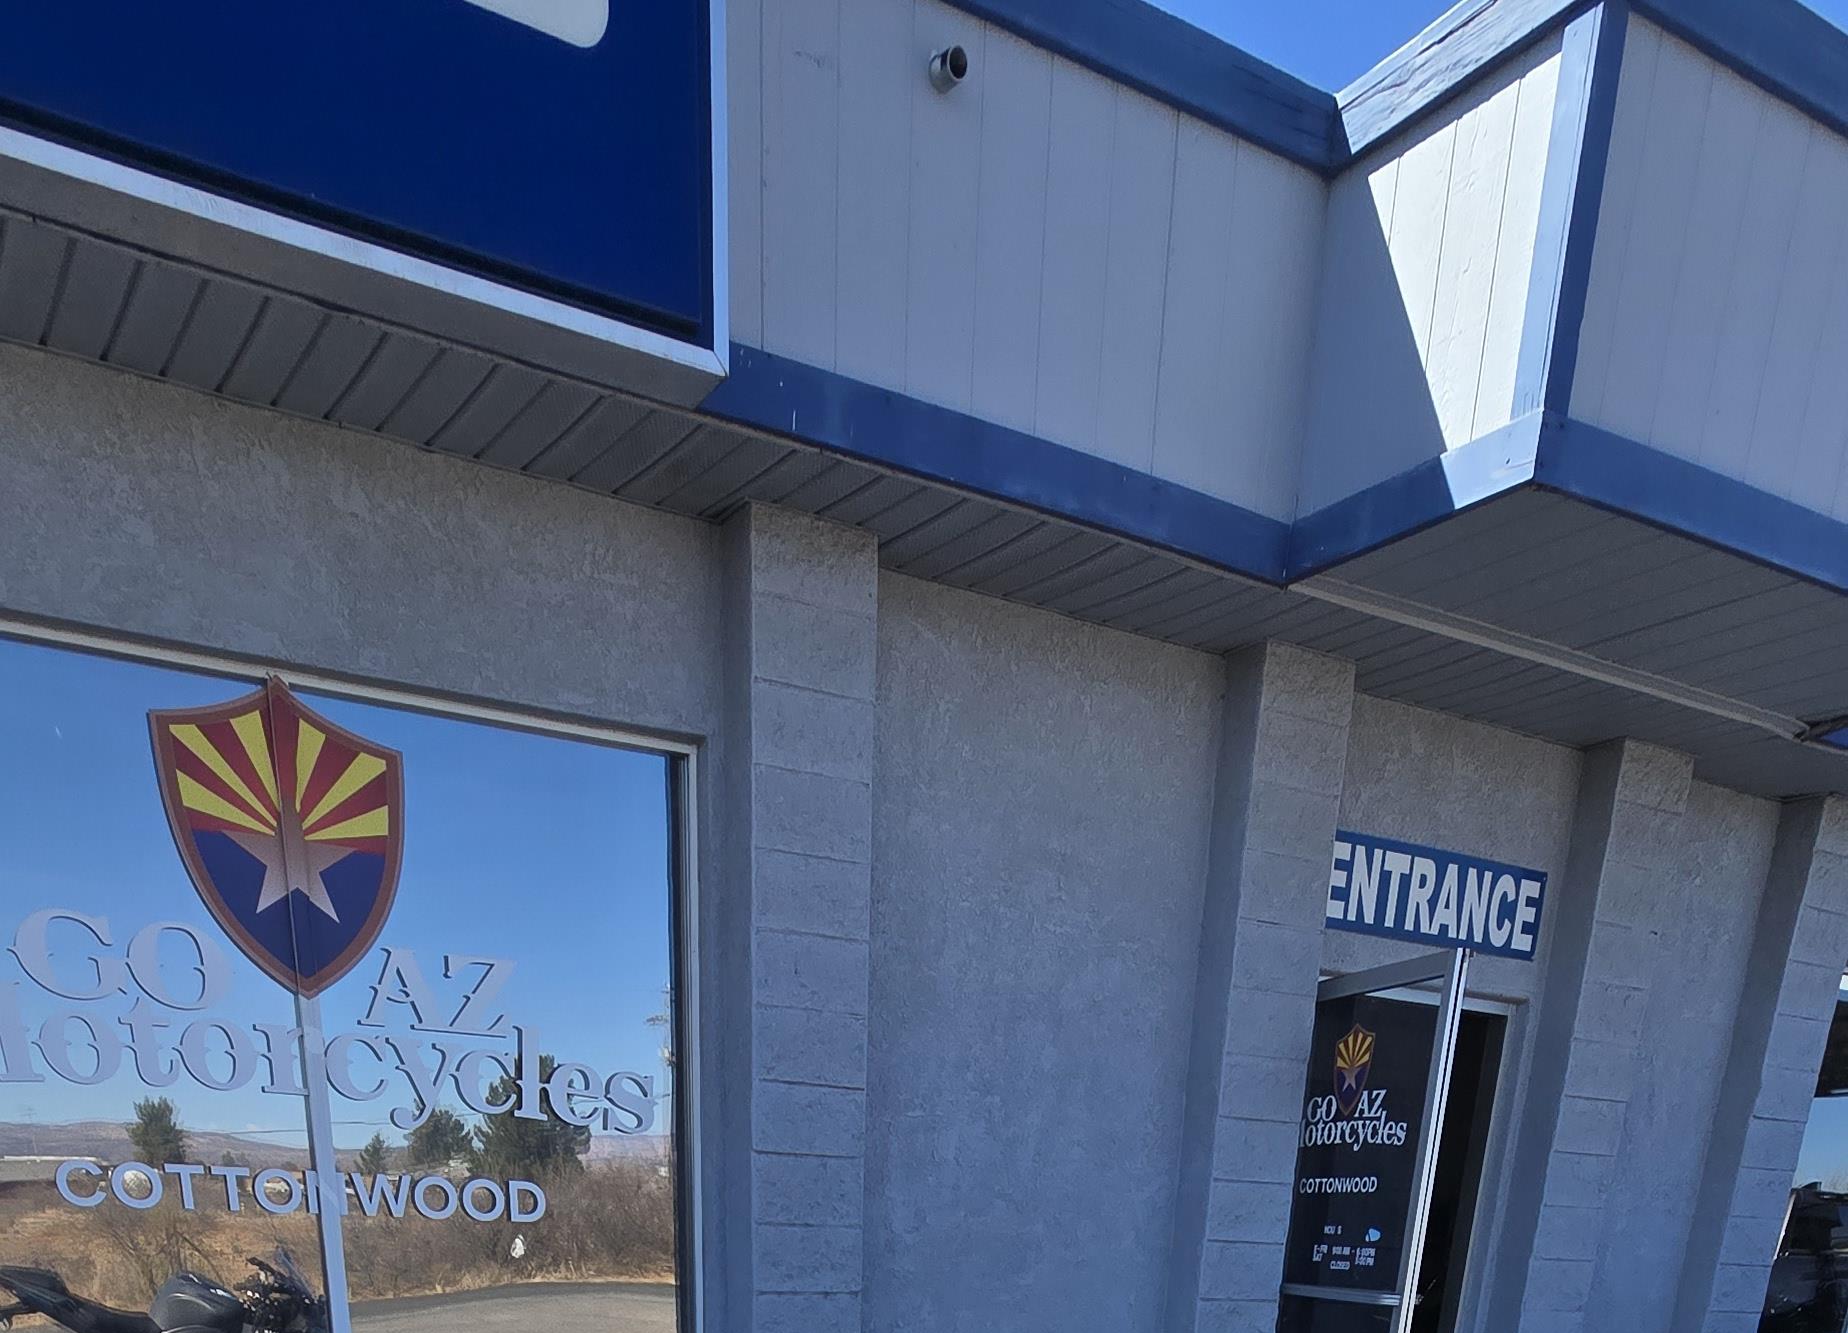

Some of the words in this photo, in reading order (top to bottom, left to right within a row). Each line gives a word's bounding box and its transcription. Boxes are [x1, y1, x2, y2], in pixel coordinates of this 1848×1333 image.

[1326, 841, 1541, 952] ENTRANCE
[7, 908, 233, 1011] GO
[357, 946, 518, 1038] AZ
[1307, 1095, 1338, 1122] GO
[1353, 1089, 1387, 1118] AZ
[55, 1159, 547, 1223] COTTONWOOD
[1299, 1176, 1378, 1194] COTTONWOOD
